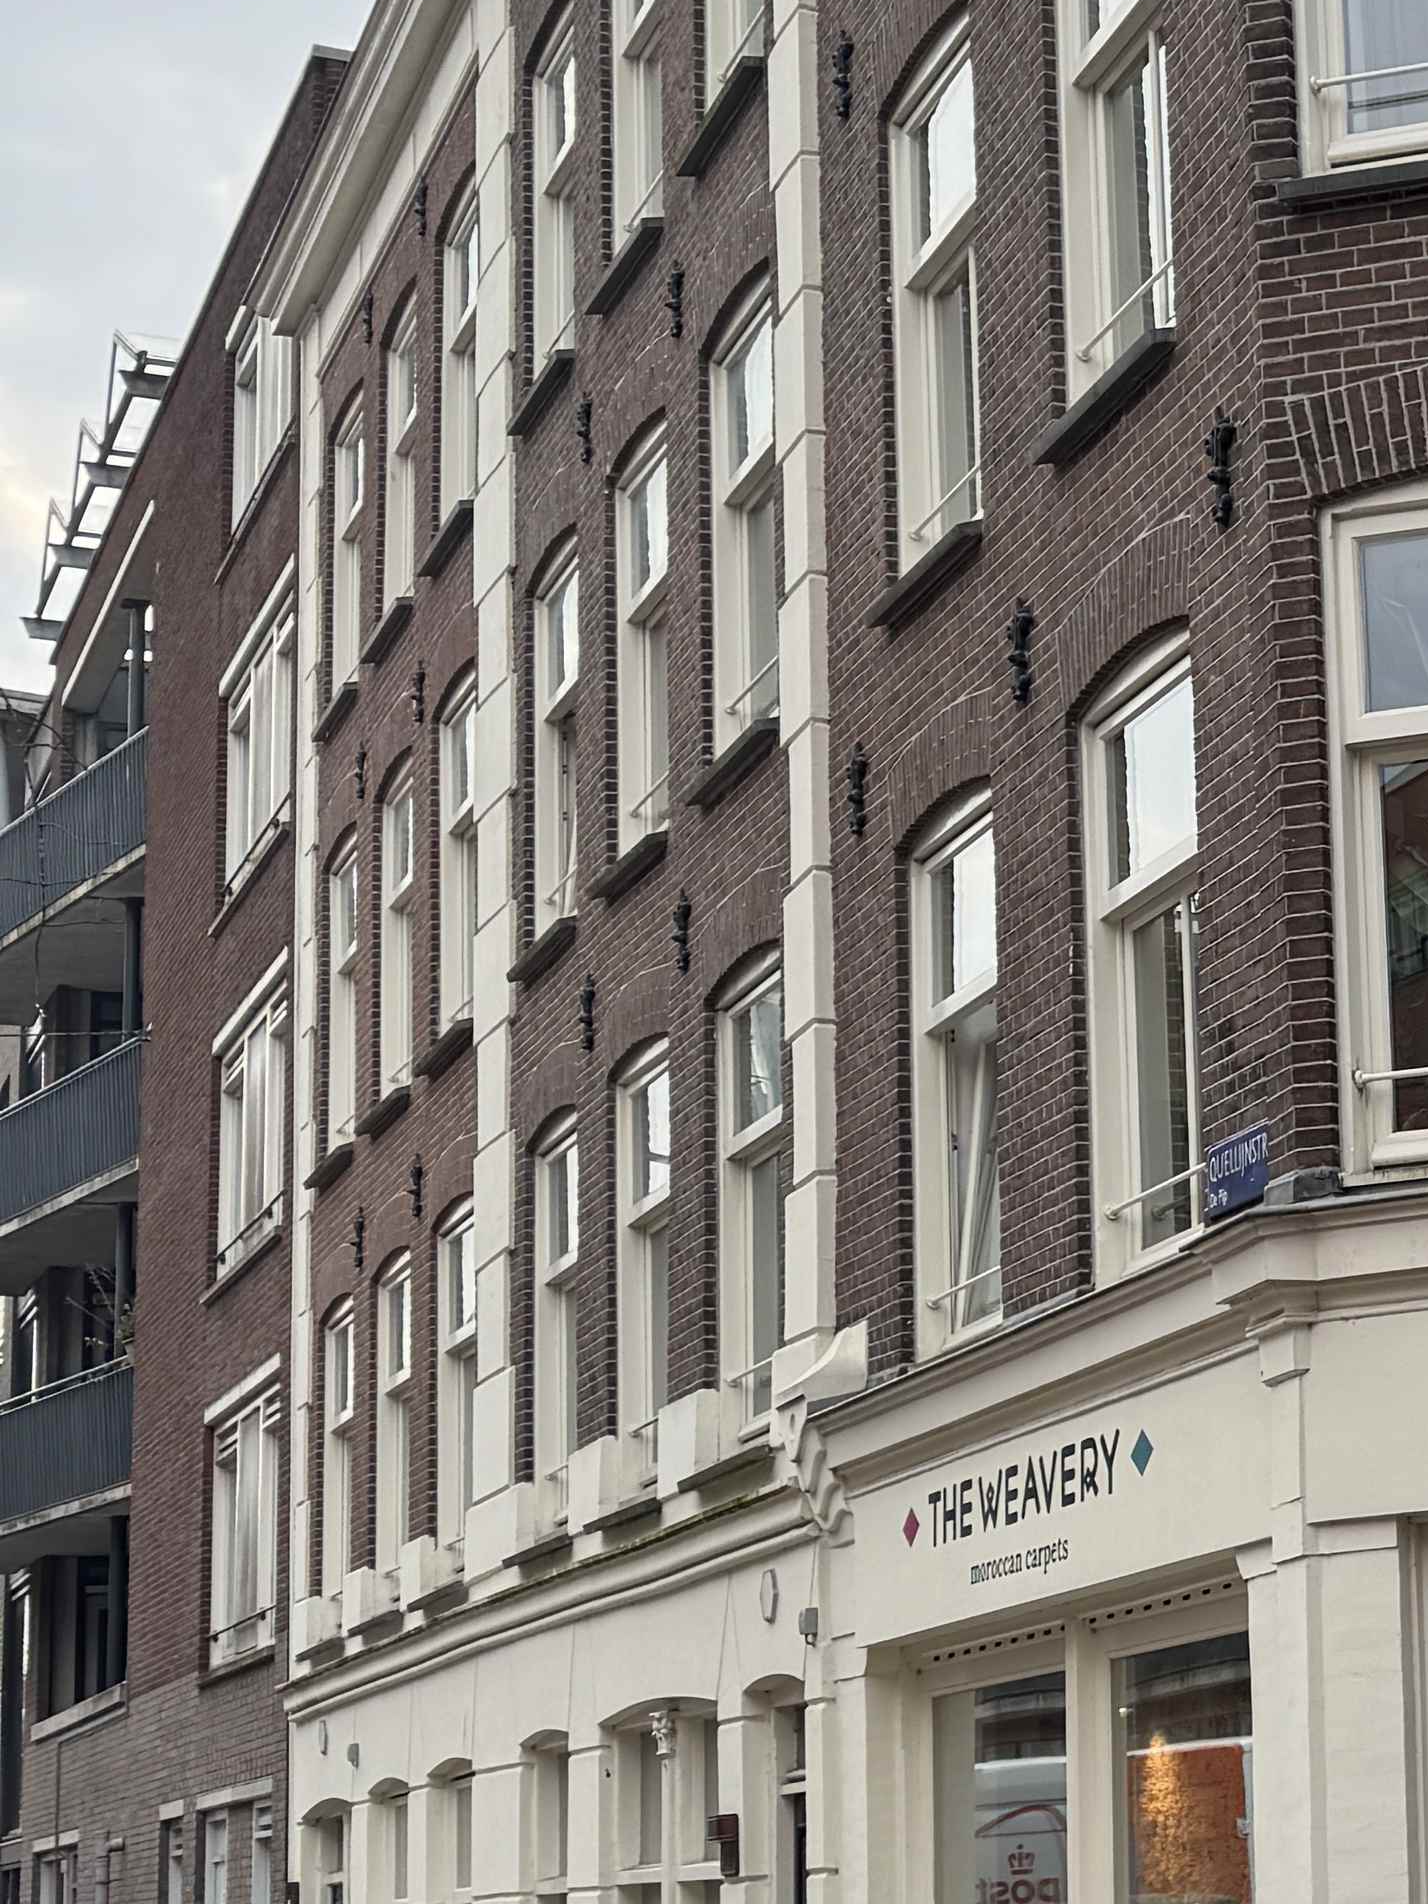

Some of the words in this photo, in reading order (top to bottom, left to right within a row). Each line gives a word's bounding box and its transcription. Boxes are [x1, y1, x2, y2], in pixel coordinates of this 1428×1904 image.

[928, 1478, 973, 1547] THE
[978, 1428, 1120, 1532] WEAVERY
[970, 1551, 1022, 1585] moroccan
[1025, 1538, 1069, 1574] carpets
